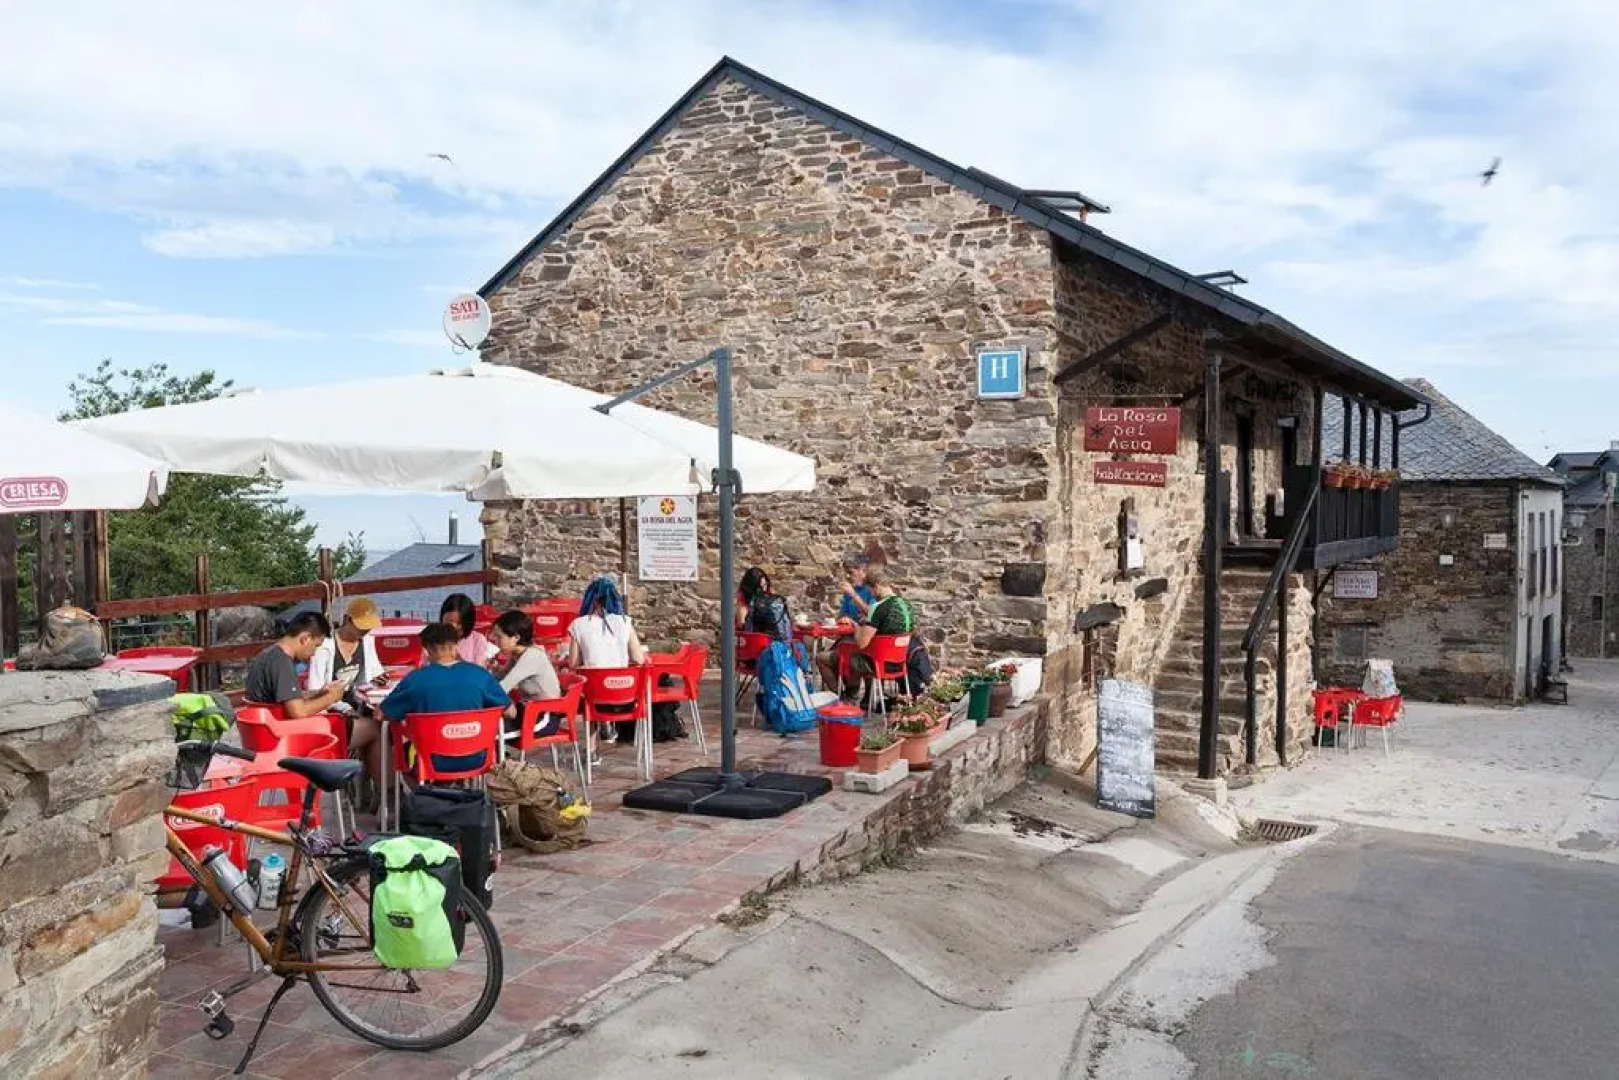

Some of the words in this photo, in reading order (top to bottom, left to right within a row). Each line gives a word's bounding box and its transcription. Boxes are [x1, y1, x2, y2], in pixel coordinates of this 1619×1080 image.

[992, 356, 1008, 379] H
[1099, 409, 1118, 422] La
[1123, 409, 1167, 423] Rosa
